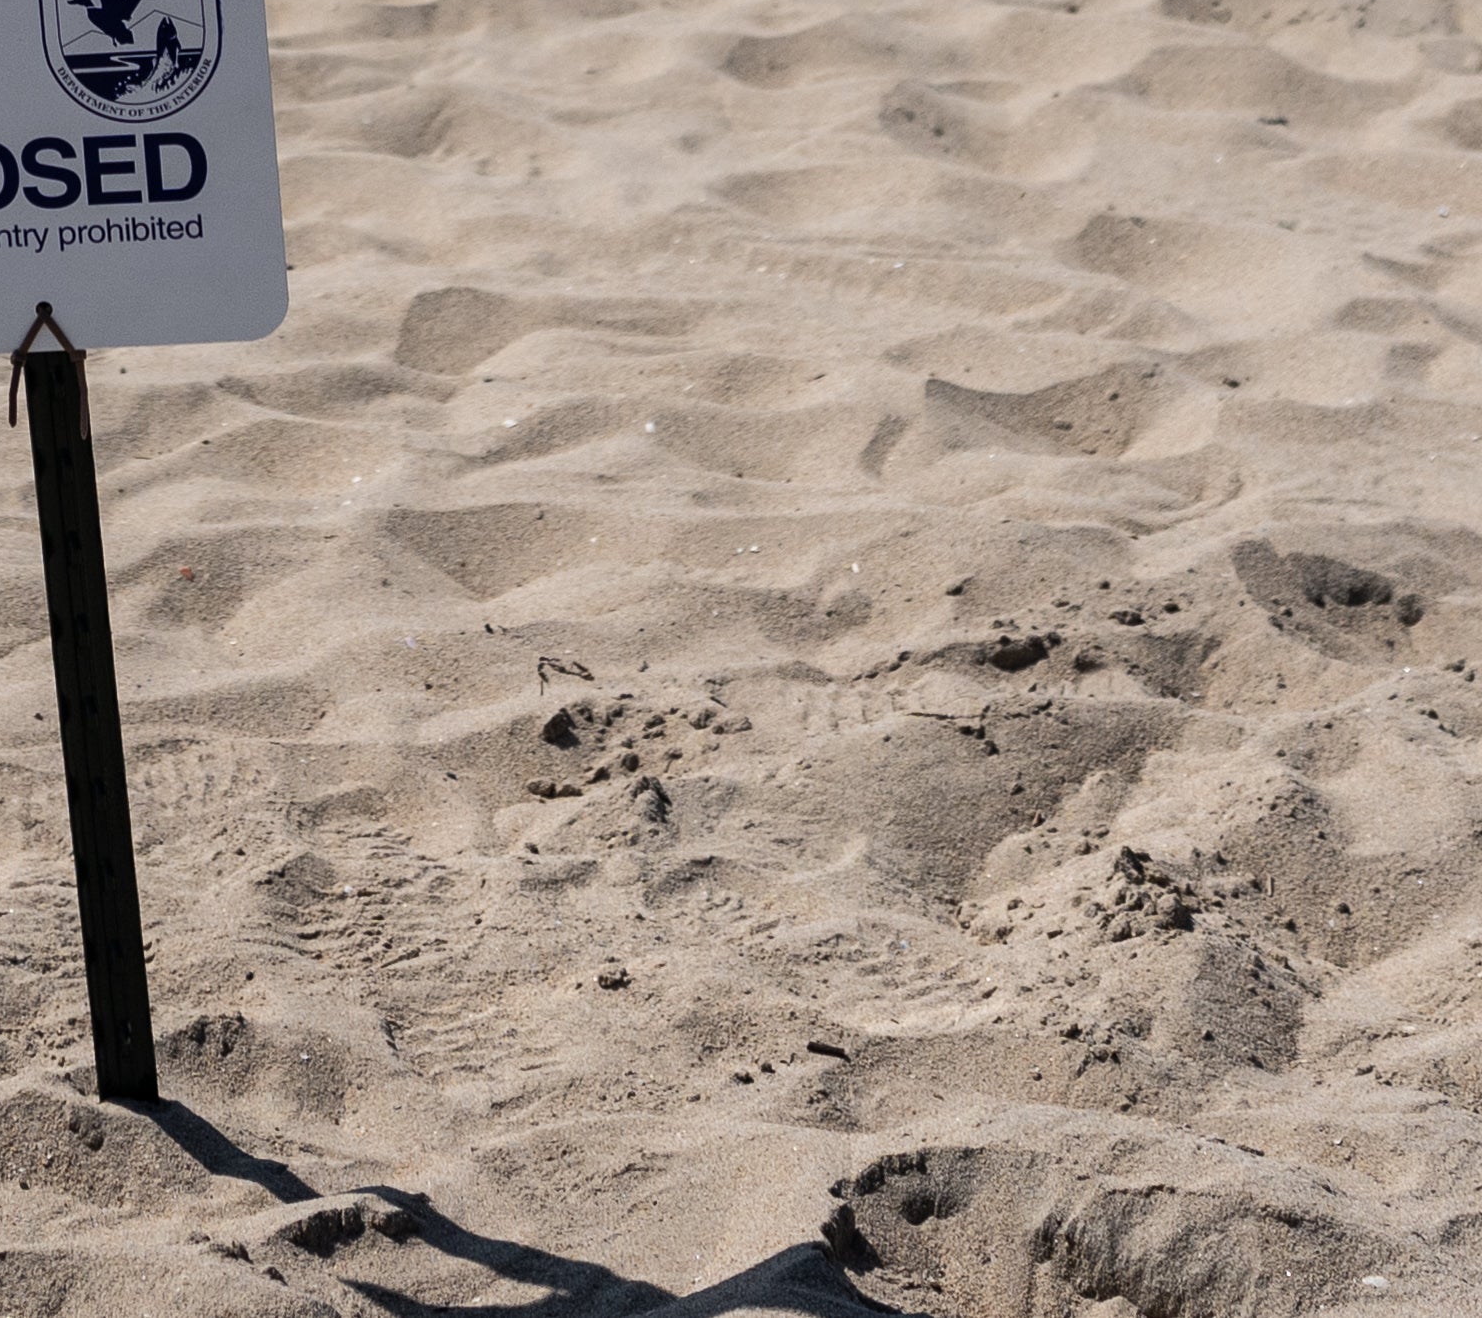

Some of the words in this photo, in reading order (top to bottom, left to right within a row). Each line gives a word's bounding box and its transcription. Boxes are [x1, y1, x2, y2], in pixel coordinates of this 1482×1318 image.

[57, 66, 126, 117] DEPARTMENT
[127, 107, 145, 117] OF
[147, 102, 173, 115] THE
[173, 57, 212, 106] INTERIOR
[59, 215, 204, 251] prohibited
